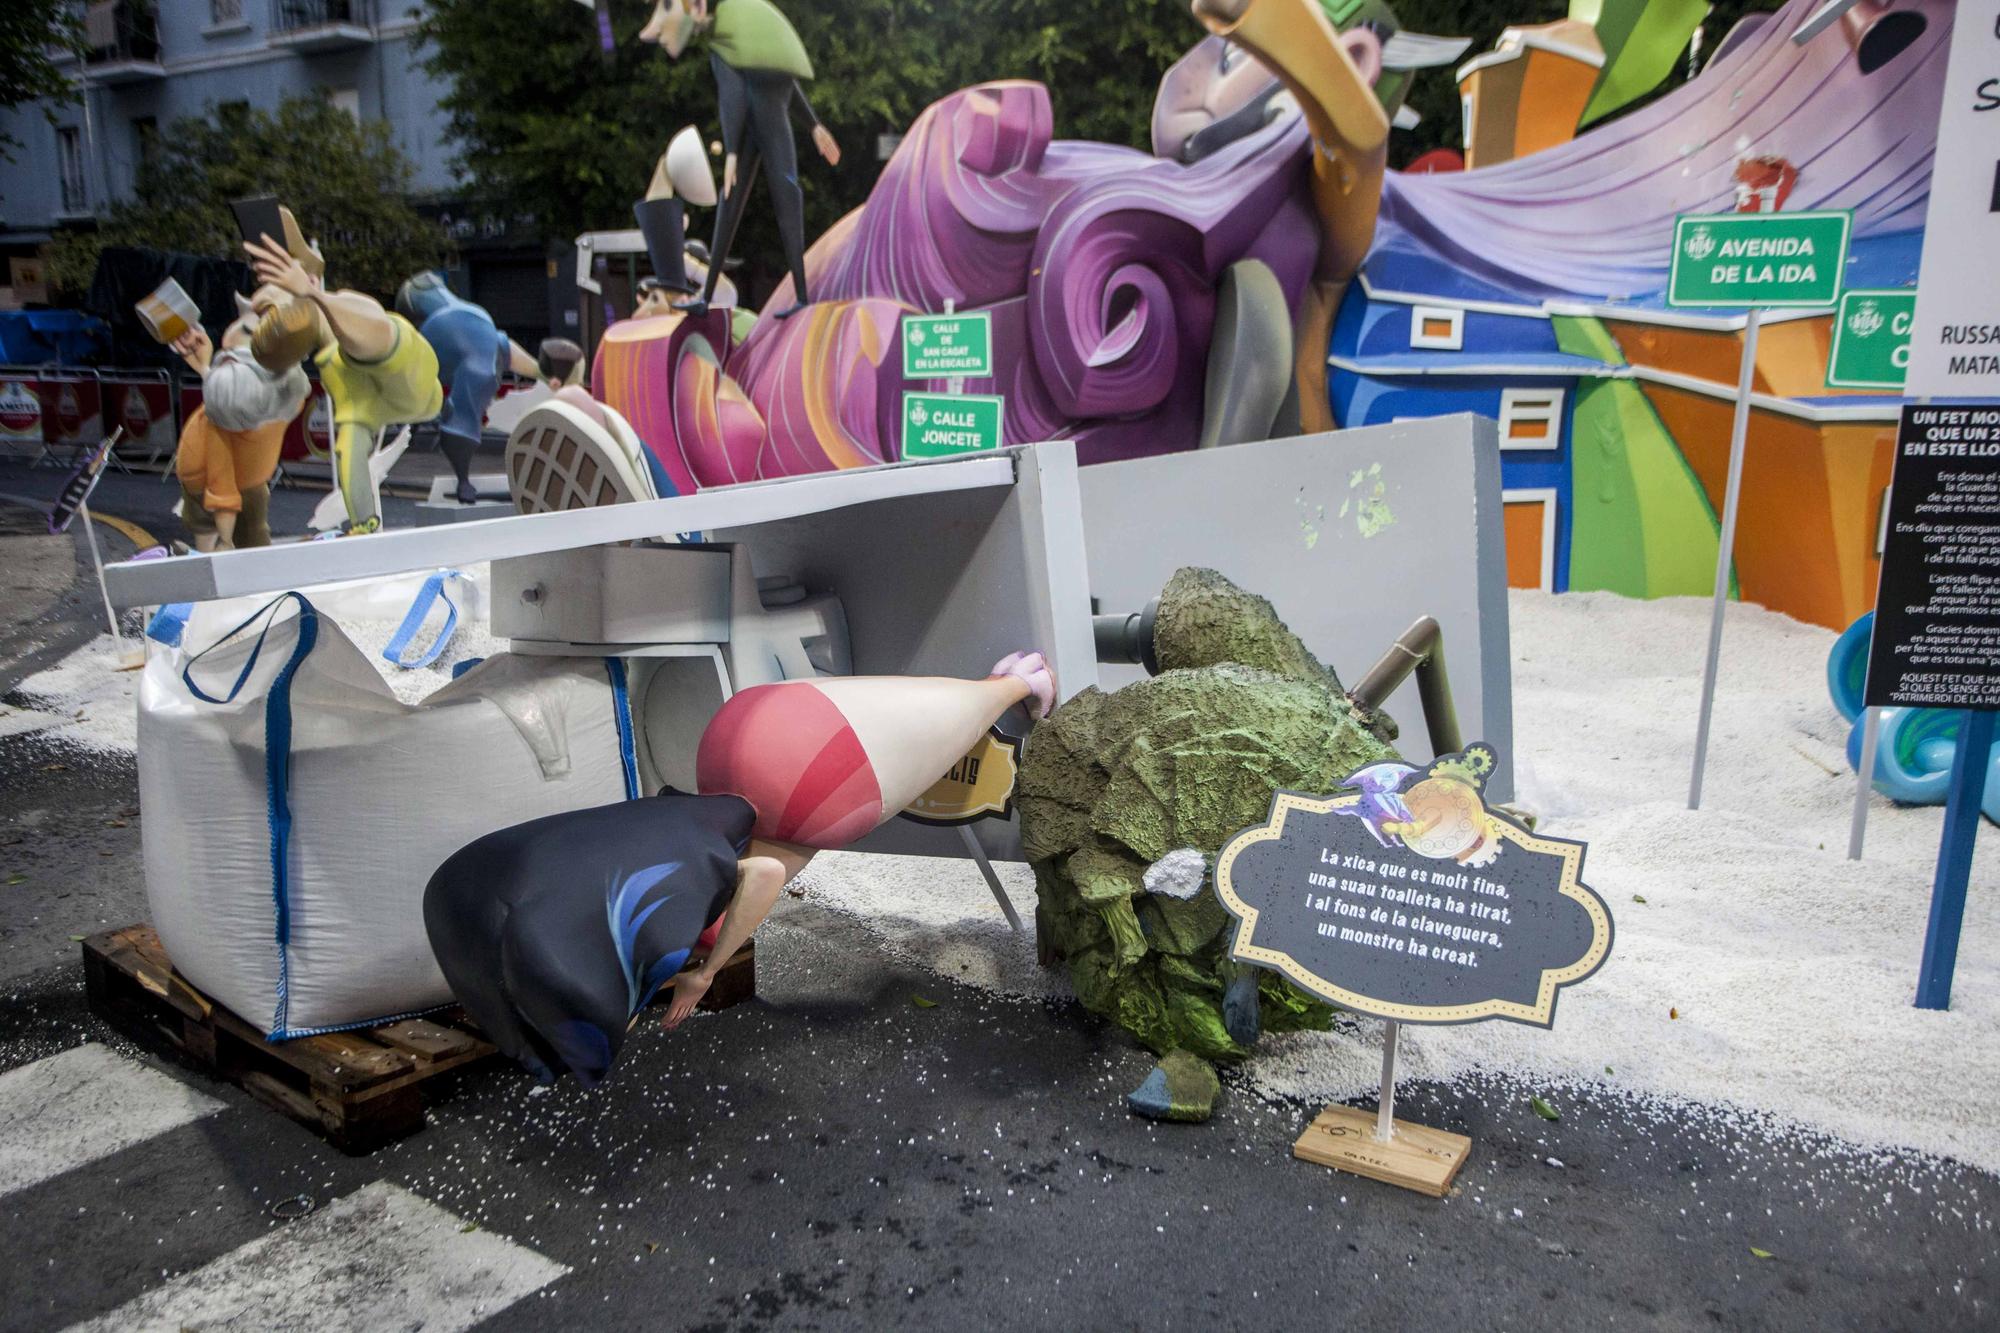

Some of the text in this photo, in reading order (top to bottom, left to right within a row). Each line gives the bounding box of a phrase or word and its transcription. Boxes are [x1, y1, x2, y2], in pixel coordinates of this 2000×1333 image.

[1718, 238, 1814, 258] AVENIDA
[1711, 264, 1816, 283] DE LA IDA
[933, 324, 960, 333] CALLE
[941, 336, 952, 345] DE
[924, 348, 940, 357] SAN
[915, 358, 982, 369] EN LA ESCALETA
[933, 411, 975, 427] CALLE
[1913, 411, 1938, 424] UN
[1939, 412, 1970, 424] FET
[922, 431, 981, 447] JONCETE
[1926, 427, 1960, 441] QUE
[1964, 427, 1987, 440] UN
[1904, 443, 1928, 456] EN
[1929, 443, 1967, 456] ESTE
[1957, 482, 1996, 491] Guardia
[1928, 492, 1940, 501] de
[1943, 494, 1962, 503] que
[1977, 495, 1998, 503] que
[1896, 523, 1913, 532] Ens
[1934, 525, 1953, 534] que
[1905, 606, 1925, 614] que
[1910, 656, 1929, 664] que
[1900, 673, 1941, 682] AQUEST
[1942, 674, 1960, 683] FET
[1962, 674, 1984, 684] QUE
[1900, 684, 1909, 692] SI
[1910, 684, 1932, 693] QUE
[1948, 685, 1979, 694] SENSE
[1953, 694, 1967, 703] DE
[1969, 695, 1984, 704] LA
[1321, 848, 1510, 899] La xica que es molt fina,
[1309, 872, 1512, 924] una suau toalleta ha tirat,
[1305, 894, 1503, 948] i al fons de la claveguera,
[1318, 922, 1478, 968] un monstre ha creat.
